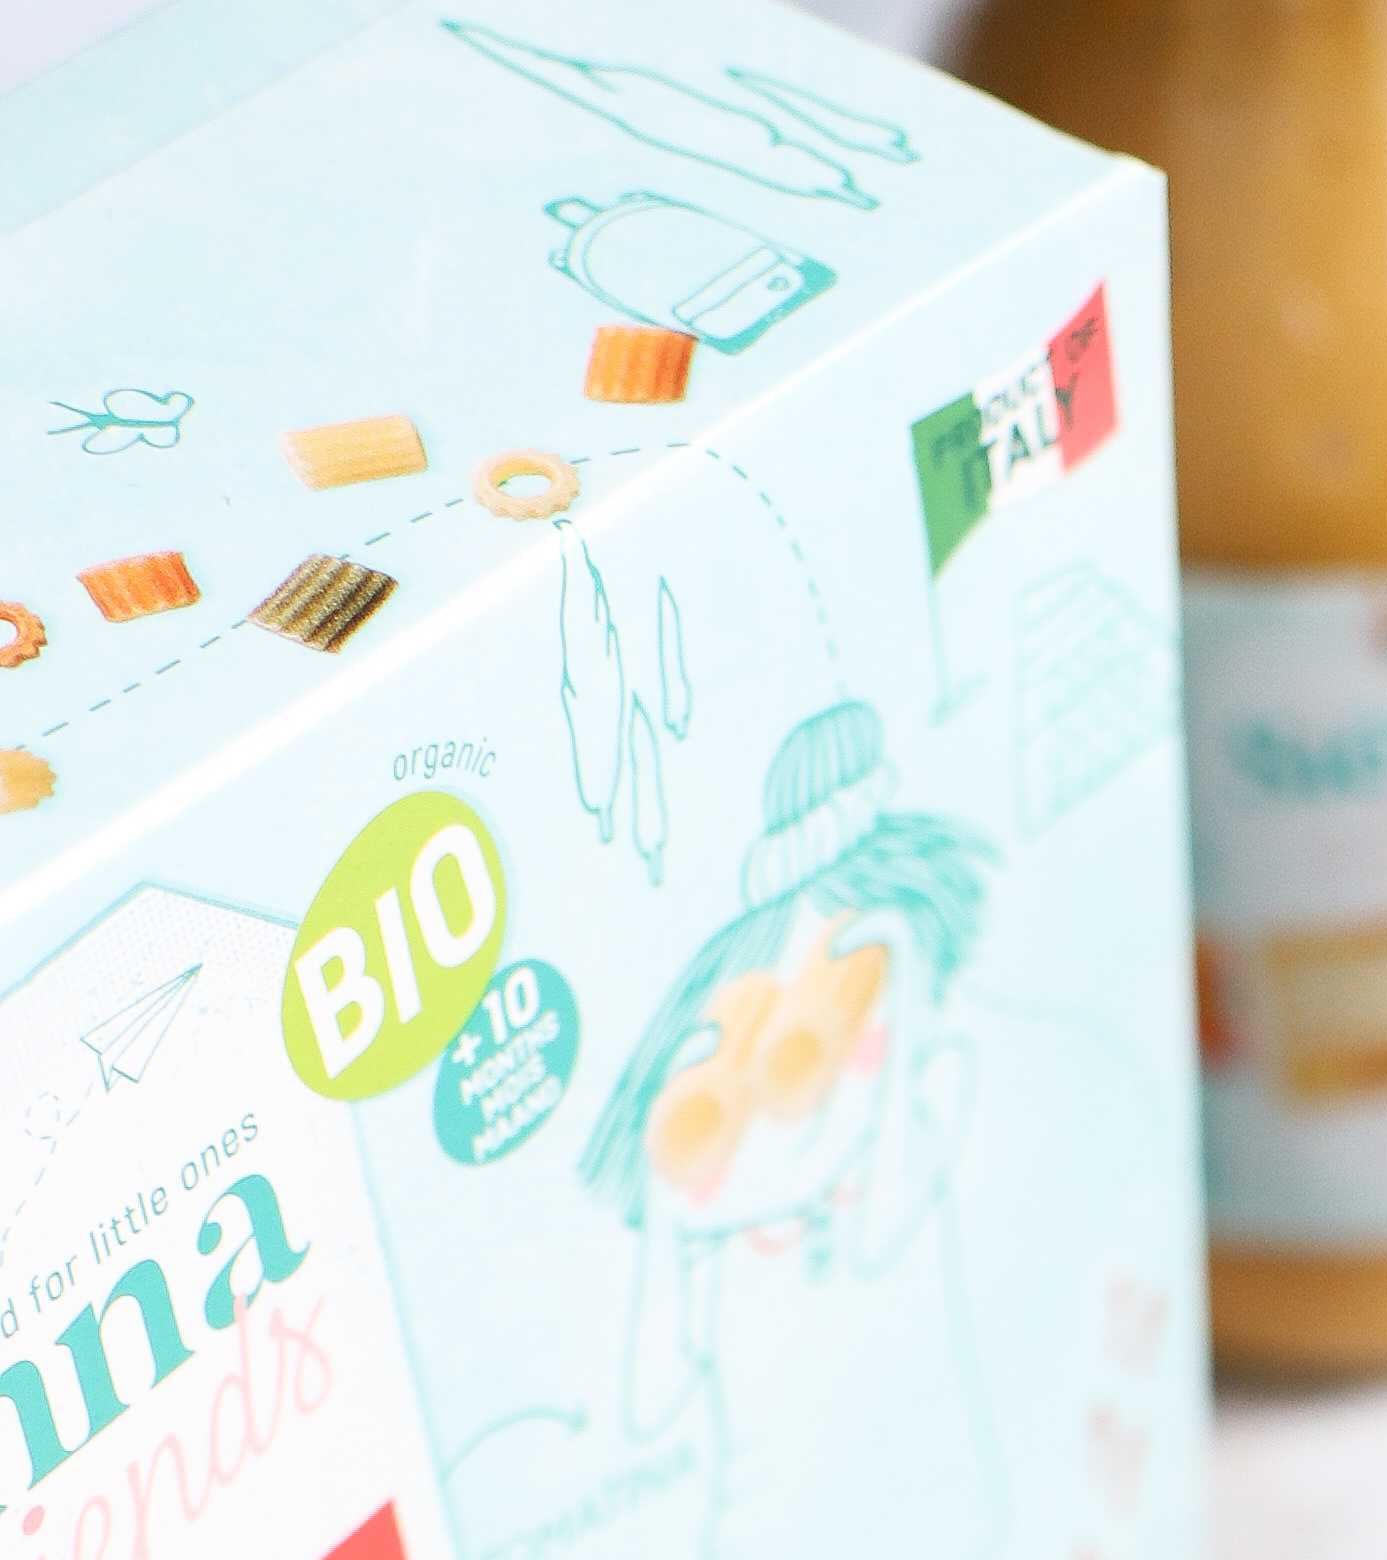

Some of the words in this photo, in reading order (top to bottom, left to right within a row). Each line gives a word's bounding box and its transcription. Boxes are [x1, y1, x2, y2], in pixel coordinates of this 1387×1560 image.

[961, 371, 1080, 513] ITALY
[393, 737, 497, 781] organic
[294, 824, 497, 1080] BIO
[28, 1255, 78, 1314] for
[89, 1186, 171, 1267] little
[181, 1113, 261, 1193] ones
